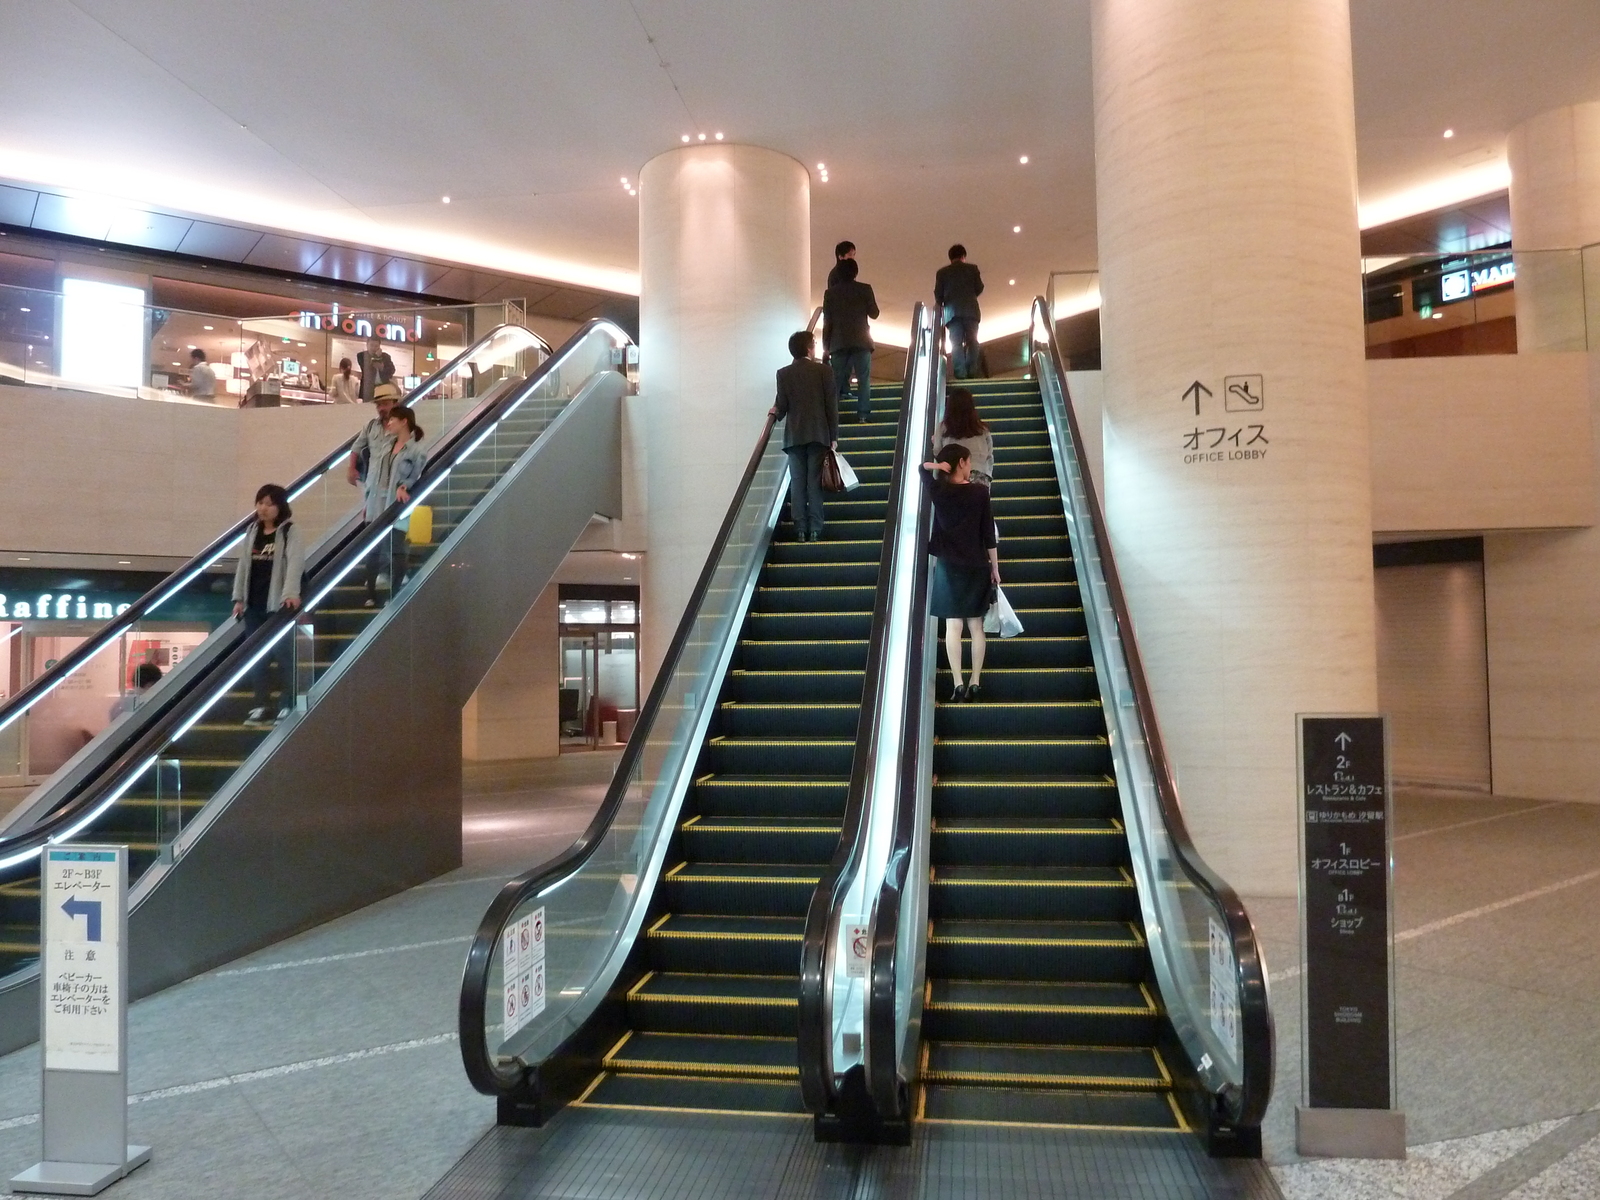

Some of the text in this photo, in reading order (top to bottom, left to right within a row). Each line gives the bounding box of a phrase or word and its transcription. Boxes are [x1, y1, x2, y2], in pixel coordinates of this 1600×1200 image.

[342, 319, 372, 337] on
[375, 315, 422, 342] and
[1183, 425, 1269, 450] オフィス
[1183, 450, 1267, 464] OFFICE LOBBY
[1336, 755, 1350, 768] 2F
[1340, 843, 1351, 855] 1F
[1311, 858, 1380, 869] オフィスロビー
[54, 881, 111, 892] エレベーター
[1331, 916, 1363, 929] ショップ
[59, 973, 102, 982] ベビーカー
[53, 983, 108, 994] 車椅子の方は
[50, 995, 111, 1005] エレベーターを
[54, 1004, 107, 1015] ご利用下さい
